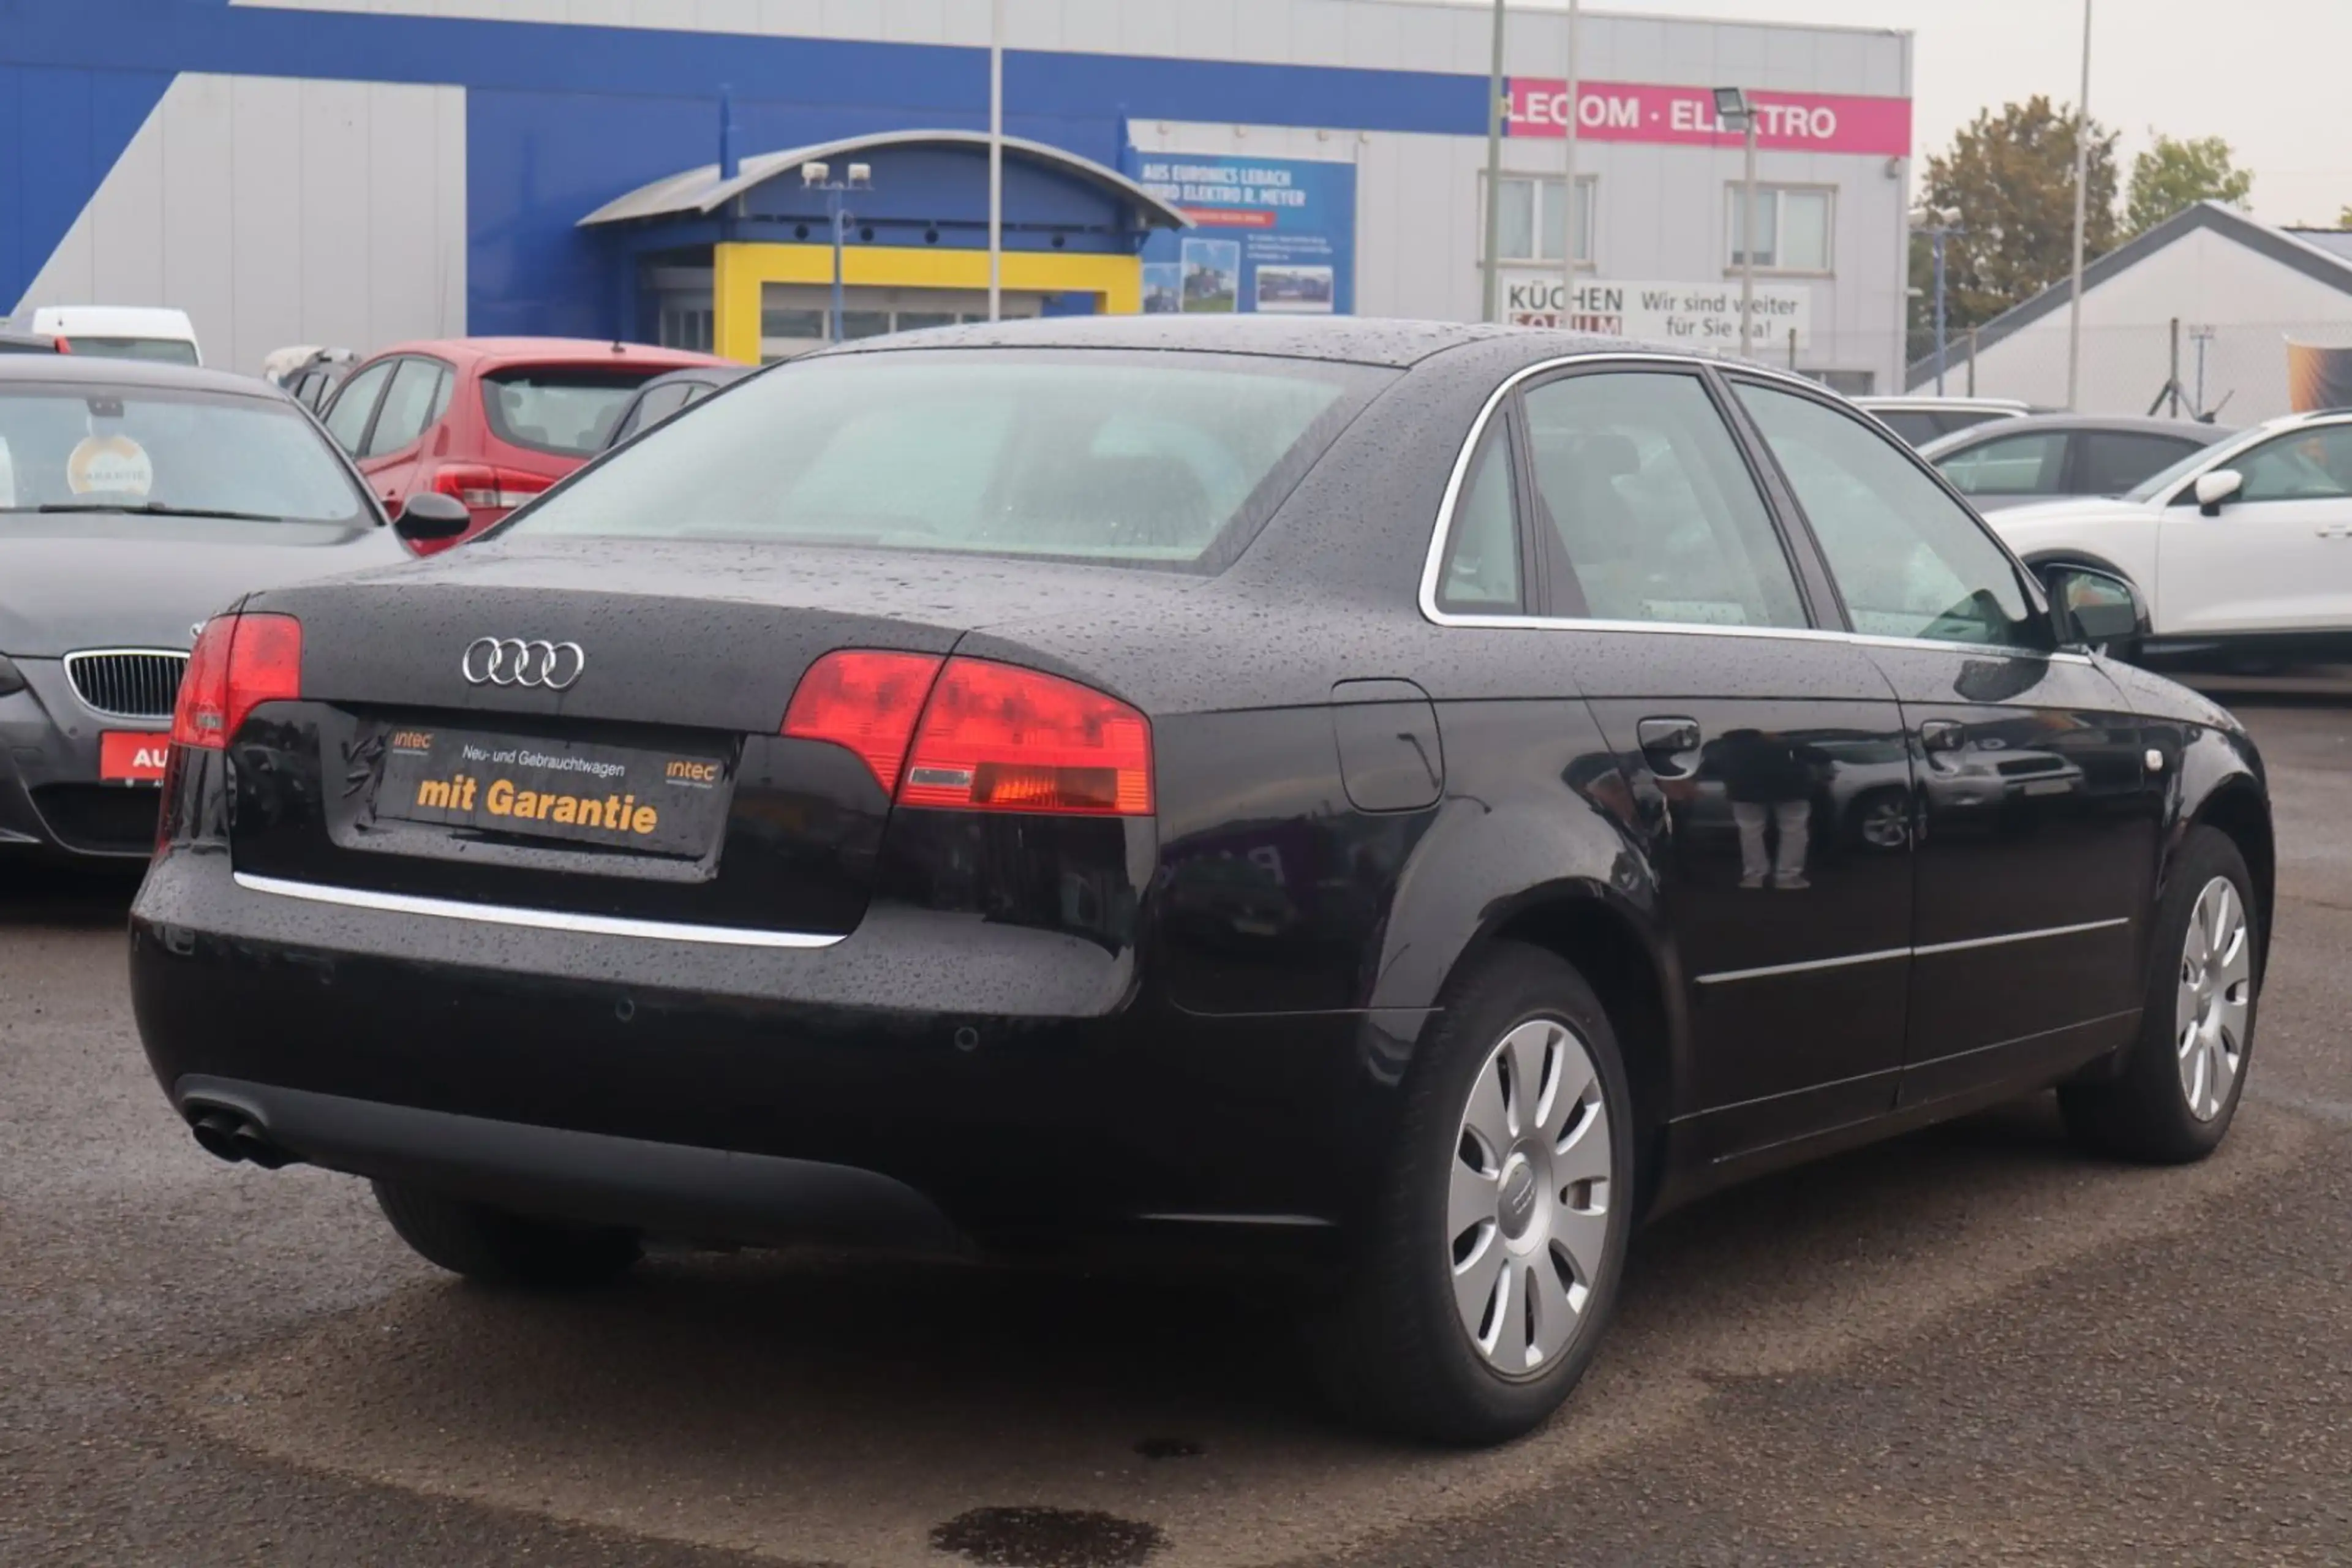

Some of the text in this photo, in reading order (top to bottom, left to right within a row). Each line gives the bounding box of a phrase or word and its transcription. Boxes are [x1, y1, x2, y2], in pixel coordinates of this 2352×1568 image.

[1670, 99, 1837, 138] ELTRO
[1509, 281, 1623, 311] KÜCHEN
[1642, 290, 1676, 311] Wir
[1684, 292, 1727, 313] sind
[1666, 315, 1697, 336] für
[1702, 316, 1732, 337] Sie
[394, 732, 433, 749] intec
[462, 744, 625, 778] Neu- und Gebrauchtwagen
[666, 760, 718, 782] intec
[417, 774, 658, 834] mit Garantie
